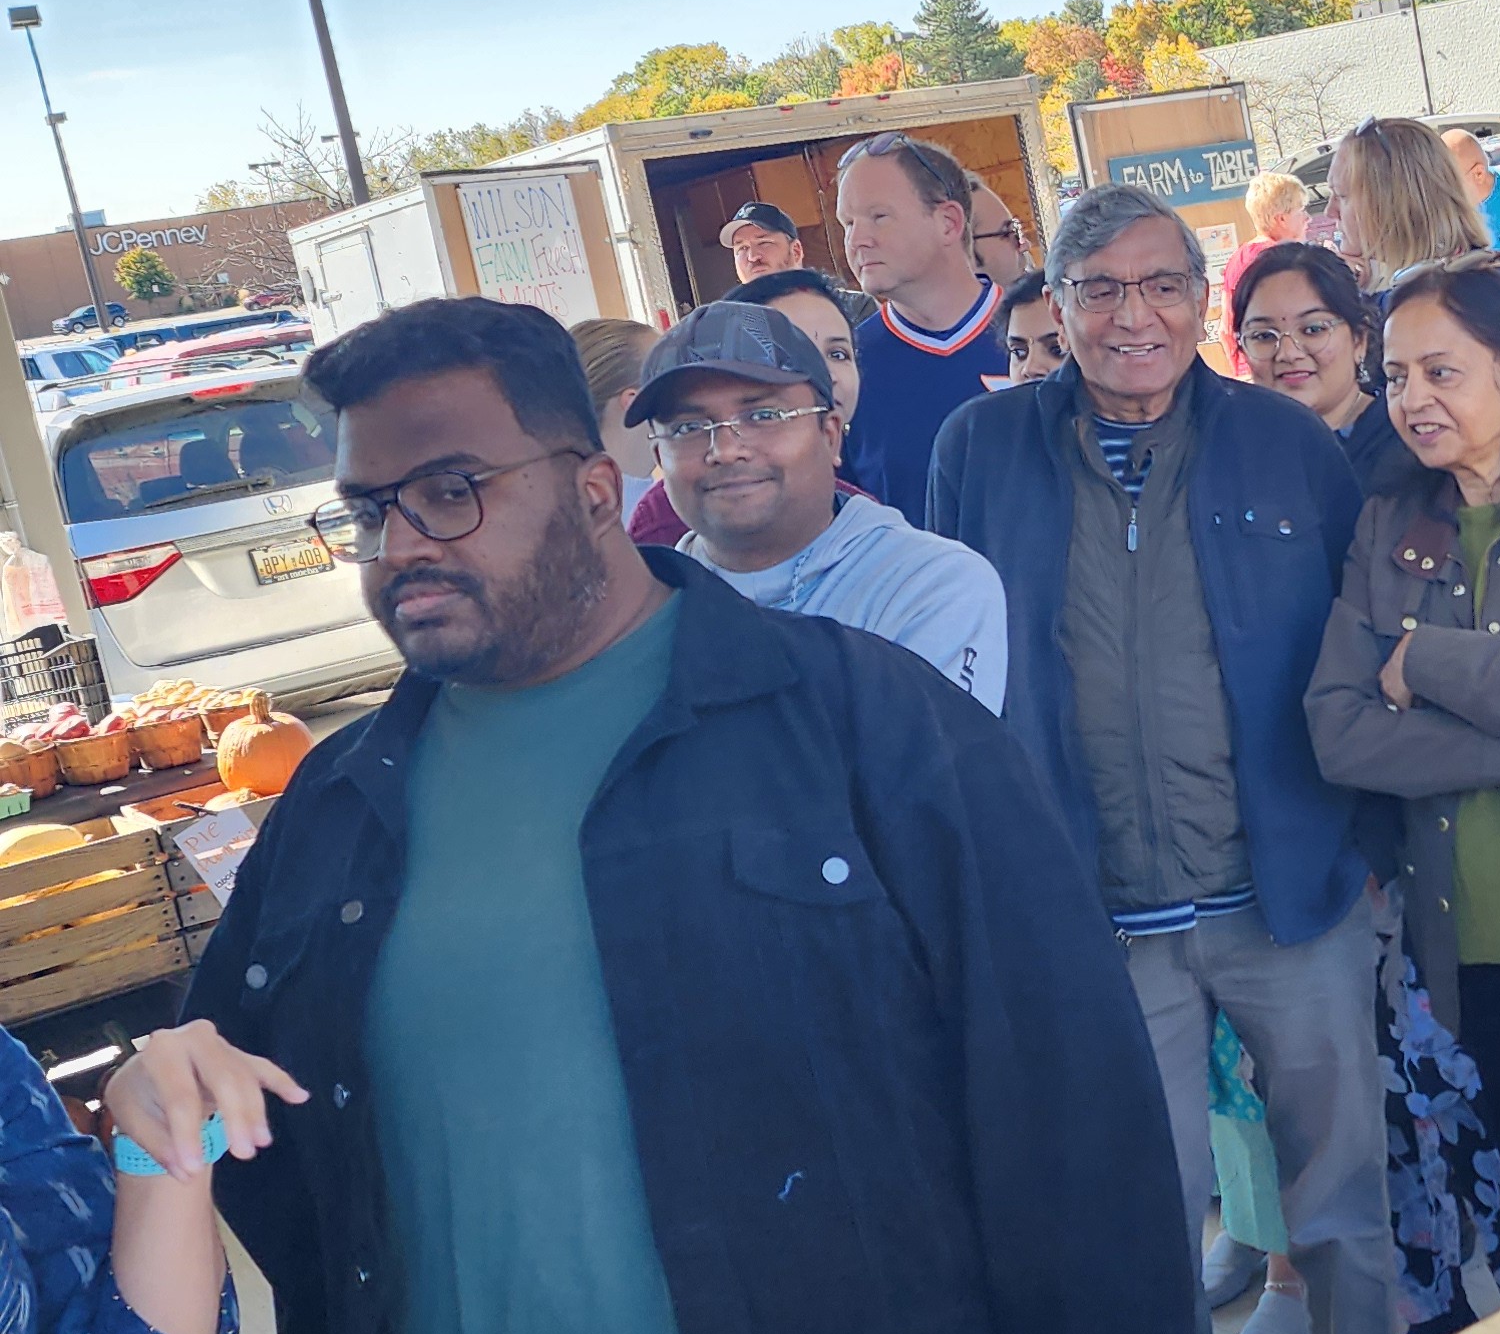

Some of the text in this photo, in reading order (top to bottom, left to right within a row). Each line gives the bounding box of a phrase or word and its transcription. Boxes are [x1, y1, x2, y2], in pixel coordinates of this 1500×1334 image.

[1122, 148, 1259, 196] FARM to TABLE
[463, 182, 570, 239] WILSON
[89, 224, 208, 256] JCPenney
[475, 238, 535, 284] FARM
